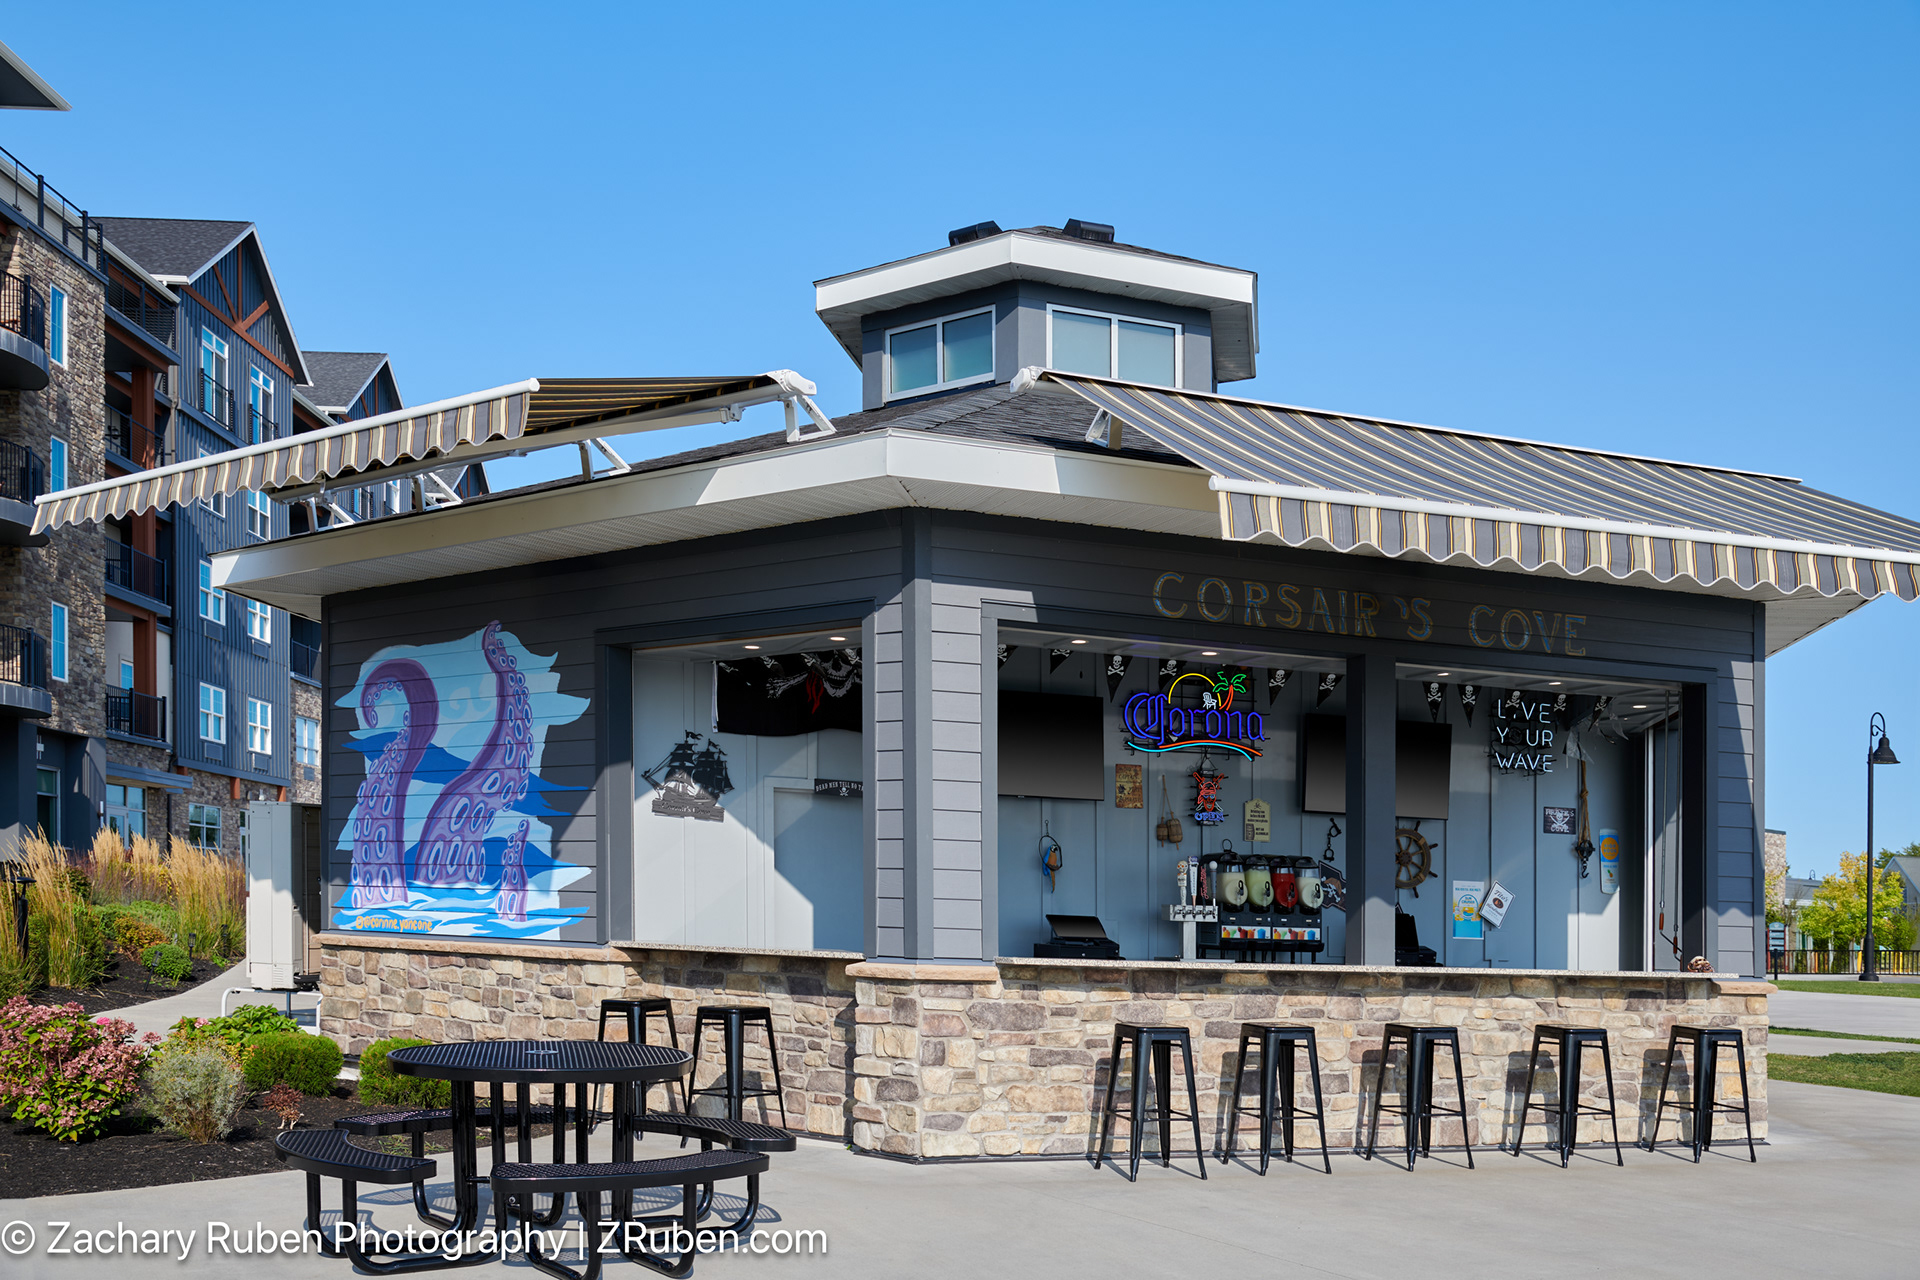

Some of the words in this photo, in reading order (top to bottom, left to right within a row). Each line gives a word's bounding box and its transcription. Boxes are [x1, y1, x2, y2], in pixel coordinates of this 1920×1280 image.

[1468, 605, 1587, 656] COVE
[1124, 692, 1265, 745] Corona
[1498, 699, 1551, 723] LVE
[1496, 752, 1553, 772] WAVE
[816, 783, 828, 792] DEAD
[1194, 812, 1224, 821] OPEN
[1494, 890, 1508, 902] Tito's
